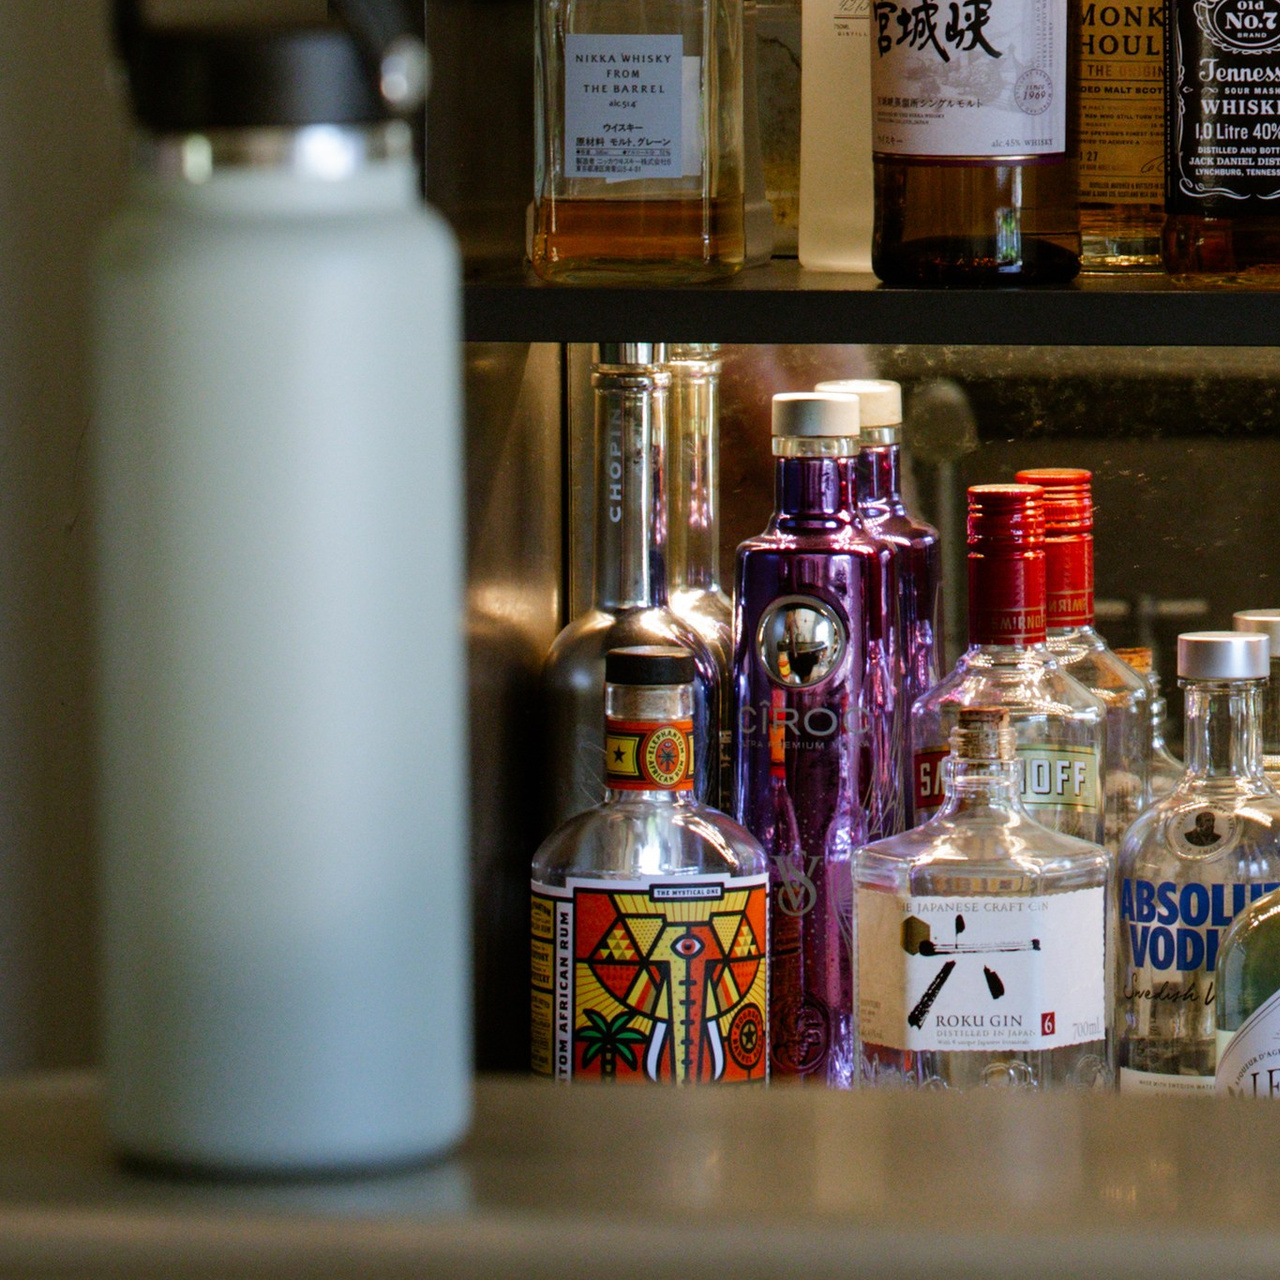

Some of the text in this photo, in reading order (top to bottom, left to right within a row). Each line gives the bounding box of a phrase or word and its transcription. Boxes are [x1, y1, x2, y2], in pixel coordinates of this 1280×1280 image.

[1237, 0, 1265, 11] Old
[1224, 11, 1279, 30] No.7
[575, 54, 672, 64] NIKKA WHISKY
[606, 69, 640, 79] FROM
[1087, 64, 1112, 77] THE
[583, 84, 665, 94] THE BARREL
[1224, 87, 1251, 95] SOUR
[1022, 90, 1047, 101] 1969
[602, 123, 644, 133] ウイスキー
[1216, 122, 1249, 140] Litre
[1197, 146, 1238, 155] DISTILLED
[1240, 146, 1257, 155] AND
[1188, 157, 1215, 166] JACK
[1216, 157, 1256, 166] DANIEL
[607, 408, 622, 524] CHOPIN
[737, 699, 871, 737] CÎROC
[671, 888, 705, 896] MYSTICAL
[917, 902, 1024, 913] JAPANESE CRAFT
[558, 911, 569, 1034] AFRICAN RUM
[1124, 973, 1202, 1006] Swedish
[936, 1014, 1023, 1028] ROKU GIN
[1044, 1015, 1053, 1033] 6
[1235, 1056, 1259, 1086] LIQUEUR
